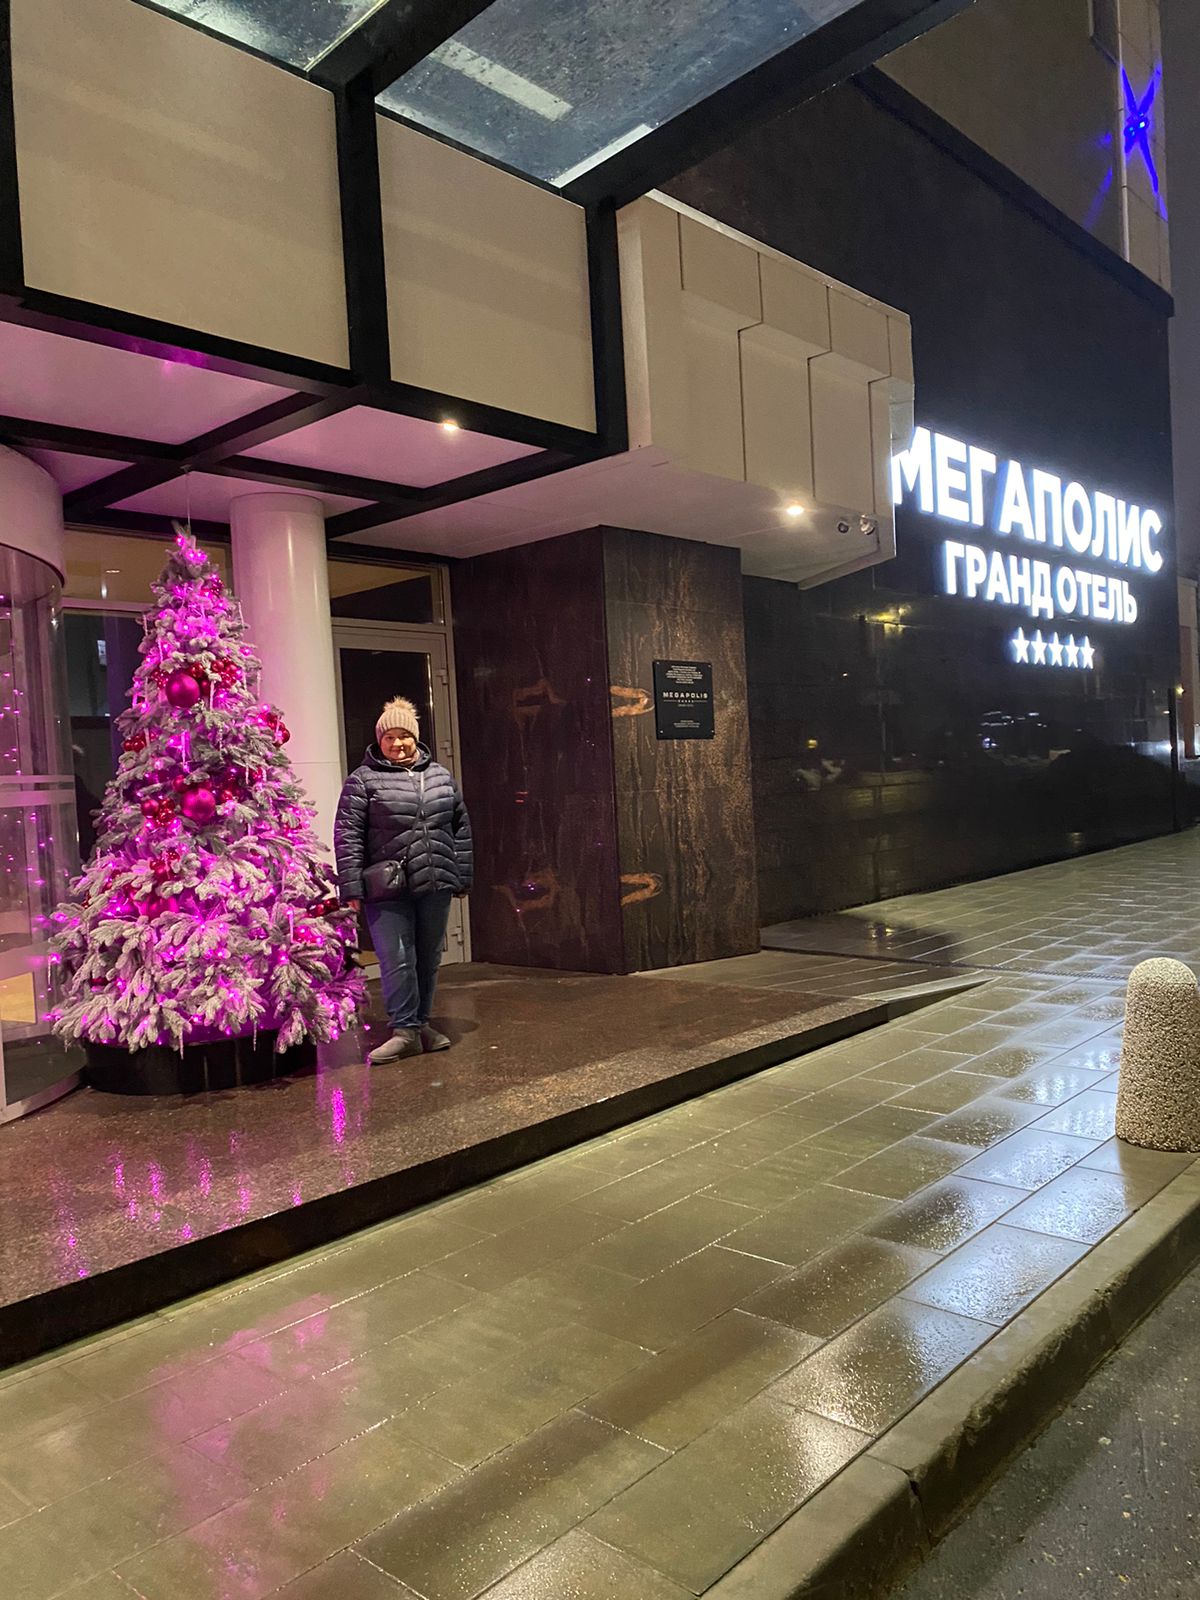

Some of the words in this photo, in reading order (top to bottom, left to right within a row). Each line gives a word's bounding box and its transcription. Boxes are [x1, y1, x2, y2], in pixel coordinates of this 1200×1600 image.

[891, 426, 1163, 572] МЕГАПОЛИС
[944, 540, 1053, 619] ГРАНД
[1056, 566, 1138, 623] ОТЕЛЬ
[662, 691, 708, 699] MEGAPOLIS
